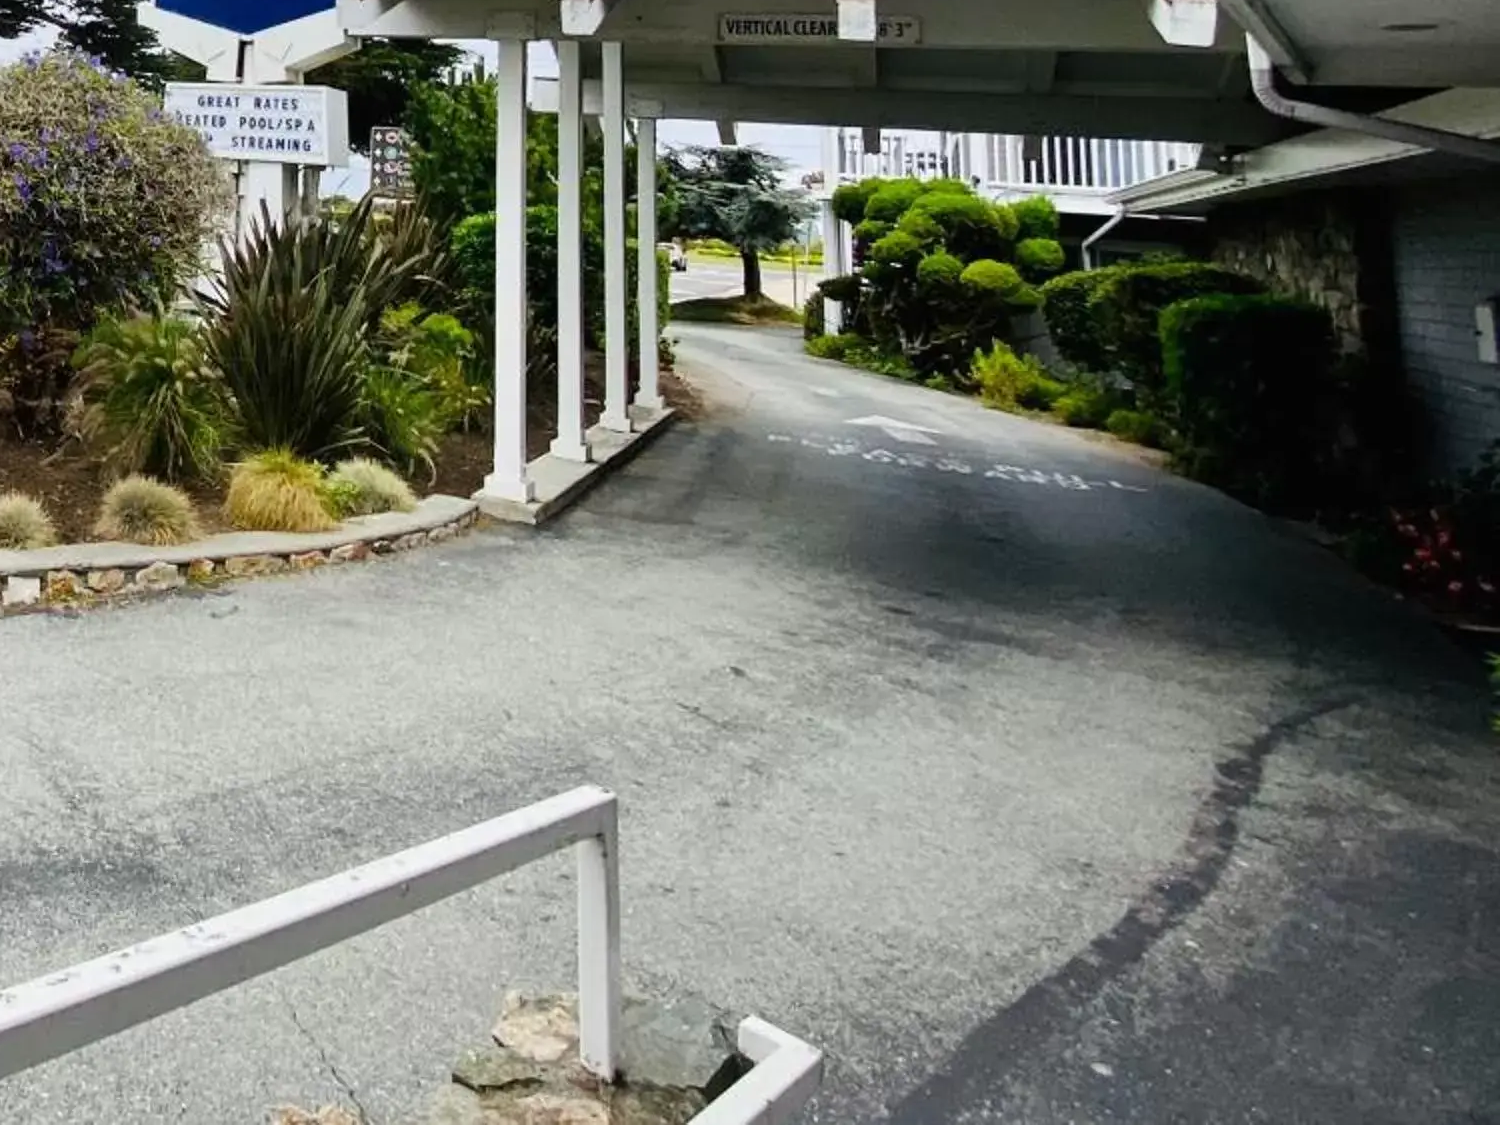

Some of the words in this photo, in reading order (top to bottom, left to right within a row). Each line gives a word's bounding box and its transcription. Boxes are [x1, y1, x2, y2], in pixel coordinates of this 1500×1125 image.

[726, 20, 790, 36] VERTICAL
[793, 20, 838, 36] CLEAR
[197, 95, 241, 108] GREAT
[253, 96, 299, 111] RATES
[231, 136, 312, 152] STREAMING
